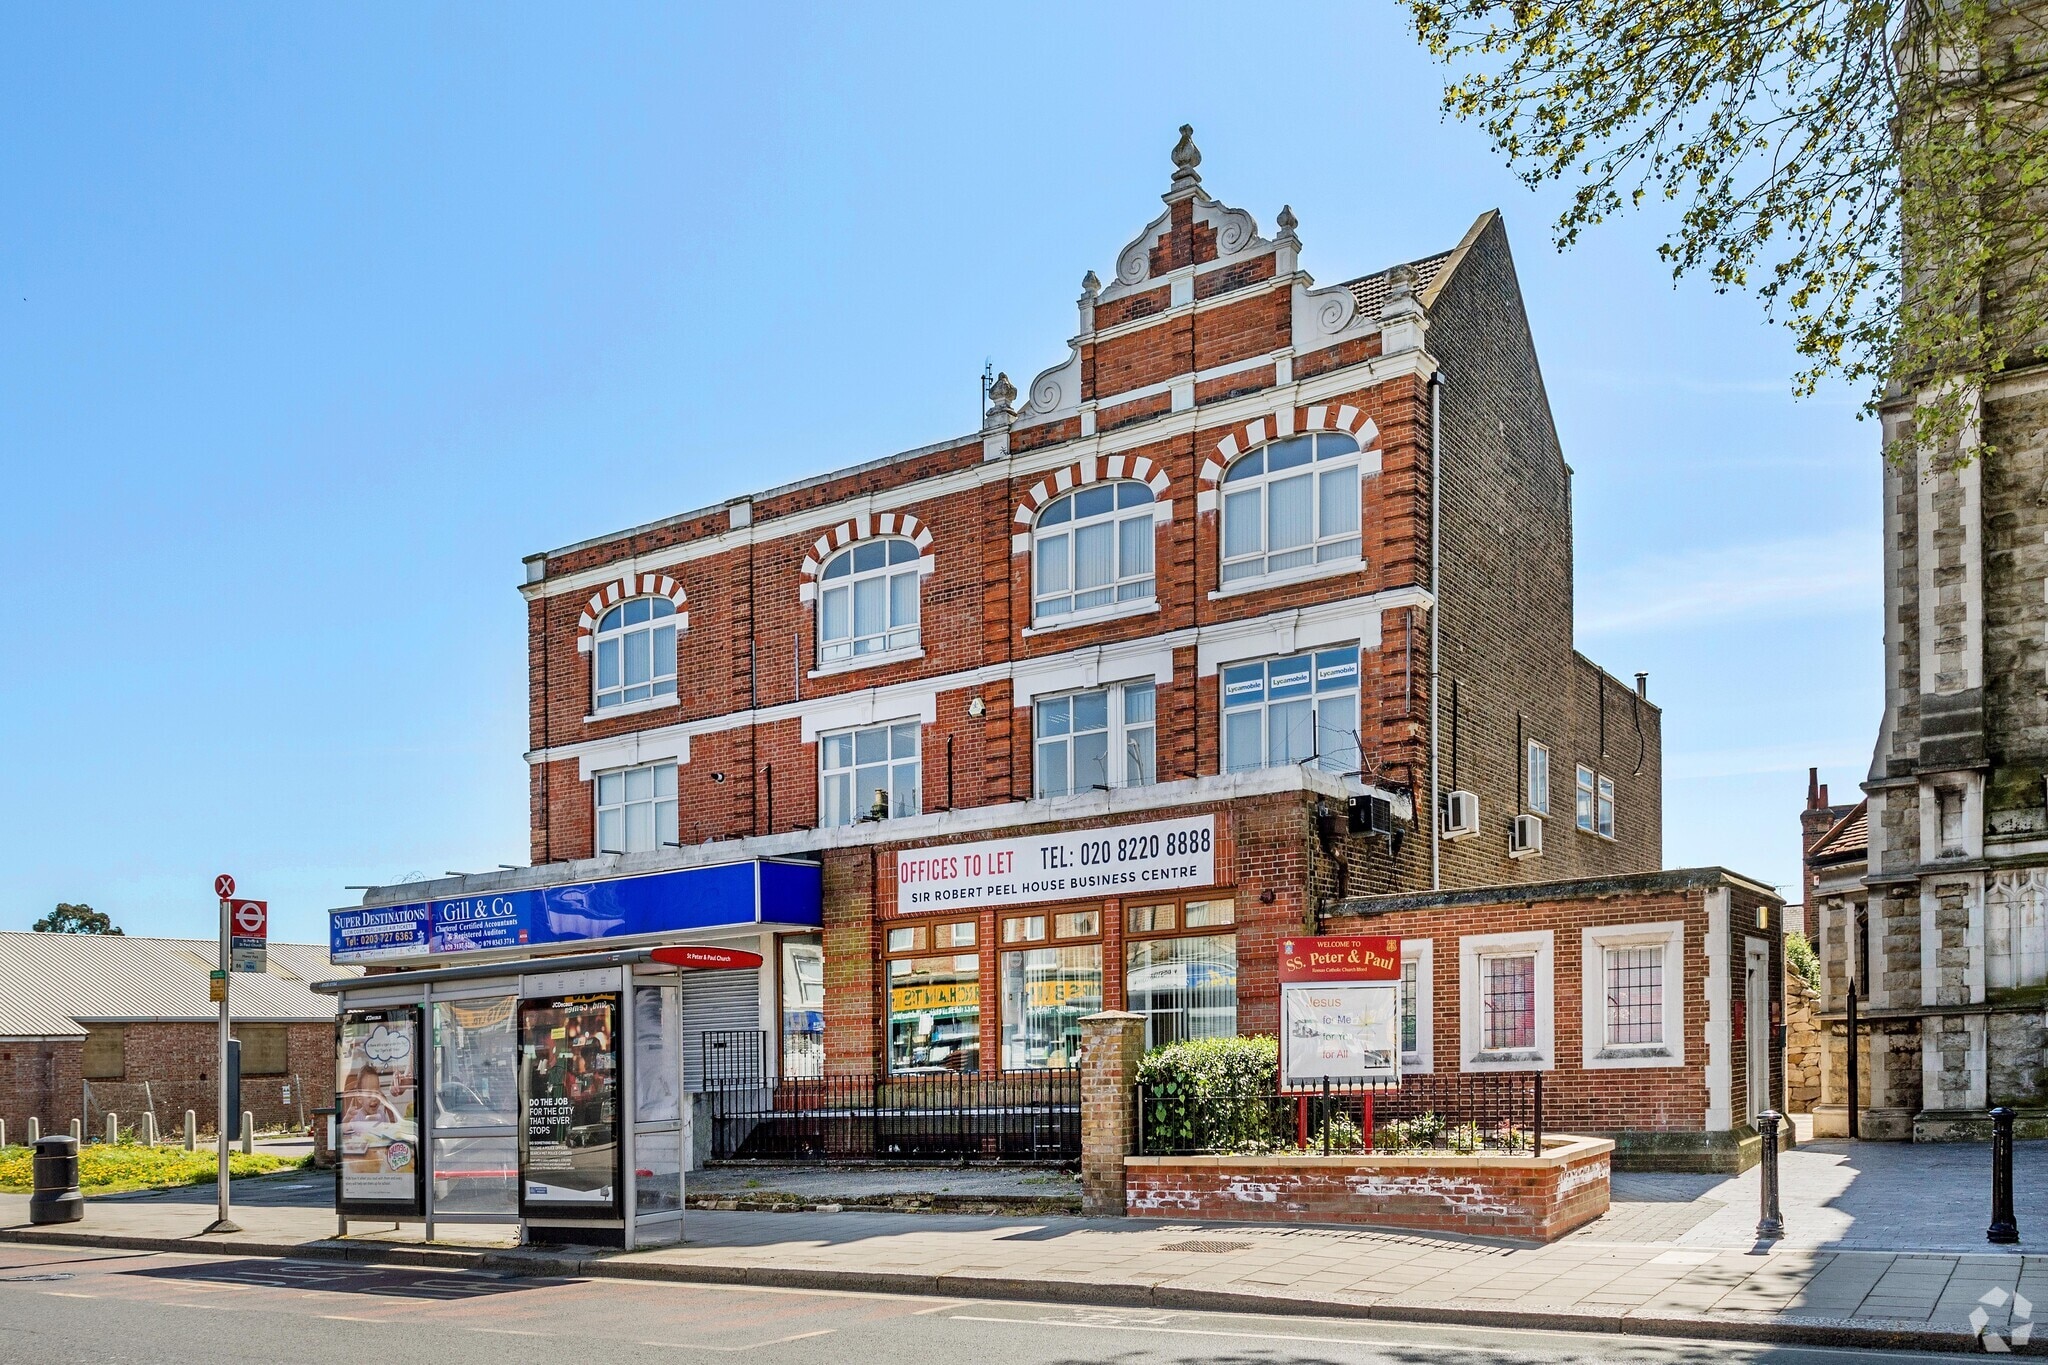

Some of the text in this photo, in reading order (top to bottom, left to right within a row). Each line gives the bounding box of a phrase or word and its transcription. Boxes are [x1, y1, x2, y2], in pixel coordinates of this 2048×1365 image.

[1319, 666, 1355, 678] Lycamobile
[1273, 674, 1308, 686] Lycamobile
[1227, 682, 1261, 693] Lycamobile
[1040, 828, 1211, 870] TEL: 020 8220 8888
[900, 851, 1014, 884] OFFICES TO LET
[219, 877, 232, 895] X
[911, 865, 1198, 903] SIR ROBERT PEEL HOUSE BUSINESS CENTRE
[443, 897, 513, 922] Gill & Co
[334, 909, 425, 930] SUPER DESTINATIONS
[435, 918, 518, 933] Chartered Certified Accountants
[345, 931, 414, 947] Tel: 0203 727 6363
[454, 930, 482, 940] Registered
[483, 928, 507, 937] Auditors
[1317, 940, 1350, 948] WELCOME
[1286, 949, 1394, 972] SS. Peter & Paul
[1306, 996, 1342, 1008] Jesus
[1337, 1015, 1352, 1024] Me
[1322, 1033, 1353, 1041] for Yo
[1322, 1050, 1349, 1059] for All
[529, 1097, 568, 1107] DO THE JOB
[529, 1106, 575, 1116] FOR THE CITY
[529, 1116, 570, 1125] THAT NEVER
[528, 1126, 551, 1135] STOPS
